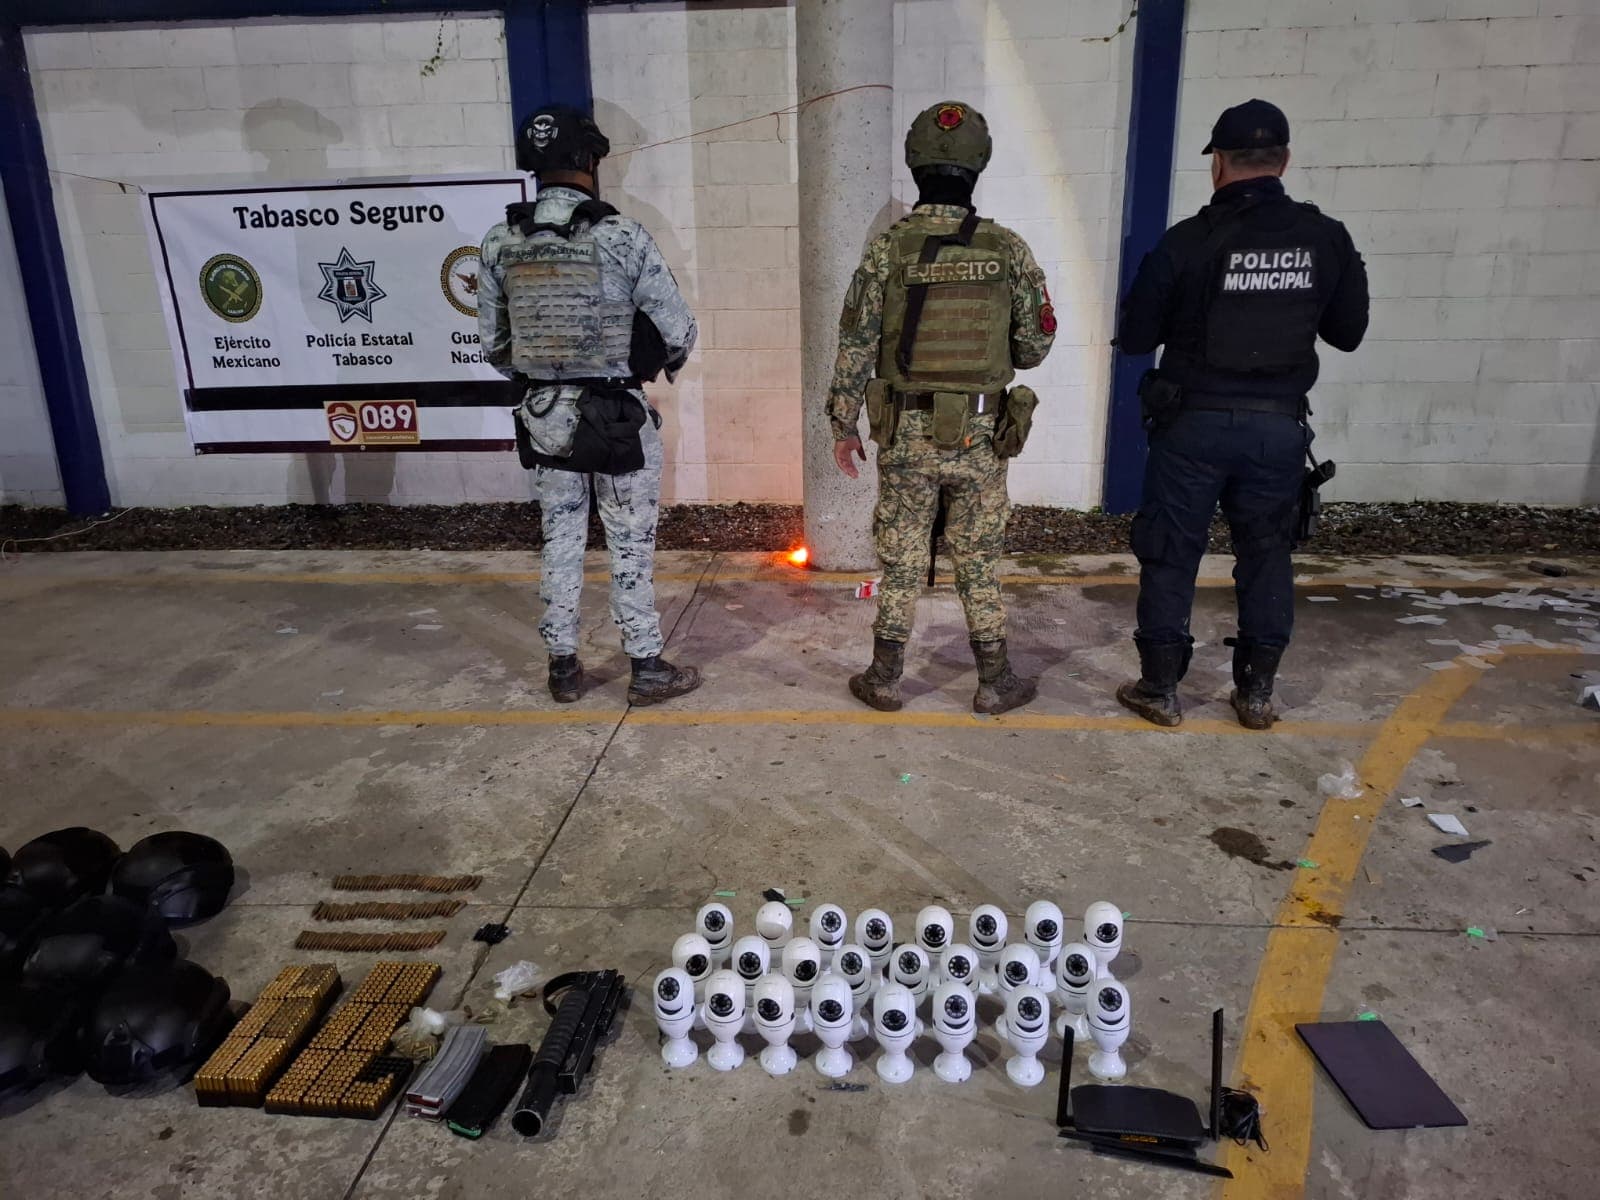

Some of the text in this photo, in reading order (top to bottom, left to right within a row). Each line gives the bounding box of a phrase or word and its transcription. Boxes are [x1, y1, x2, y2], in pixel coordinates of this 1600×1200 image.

[233, 201, 444, 231] Tabasco Seguro
[1230, 248, 1312, 269] POLICÍA
[1224, 272, 1312, 290] MUNICIPAL
[214, 336, 271, 352] Ejército
[306, 332, 414, 347] Policía Estatal
[451, 331, 480, 344] Gua
[212, 355, 281, 368] Mexicano
[332, 354, 393, 366] Tabasco
[451, 350, 489, 363] Nacio
[362, 404, 412, 429] 089
